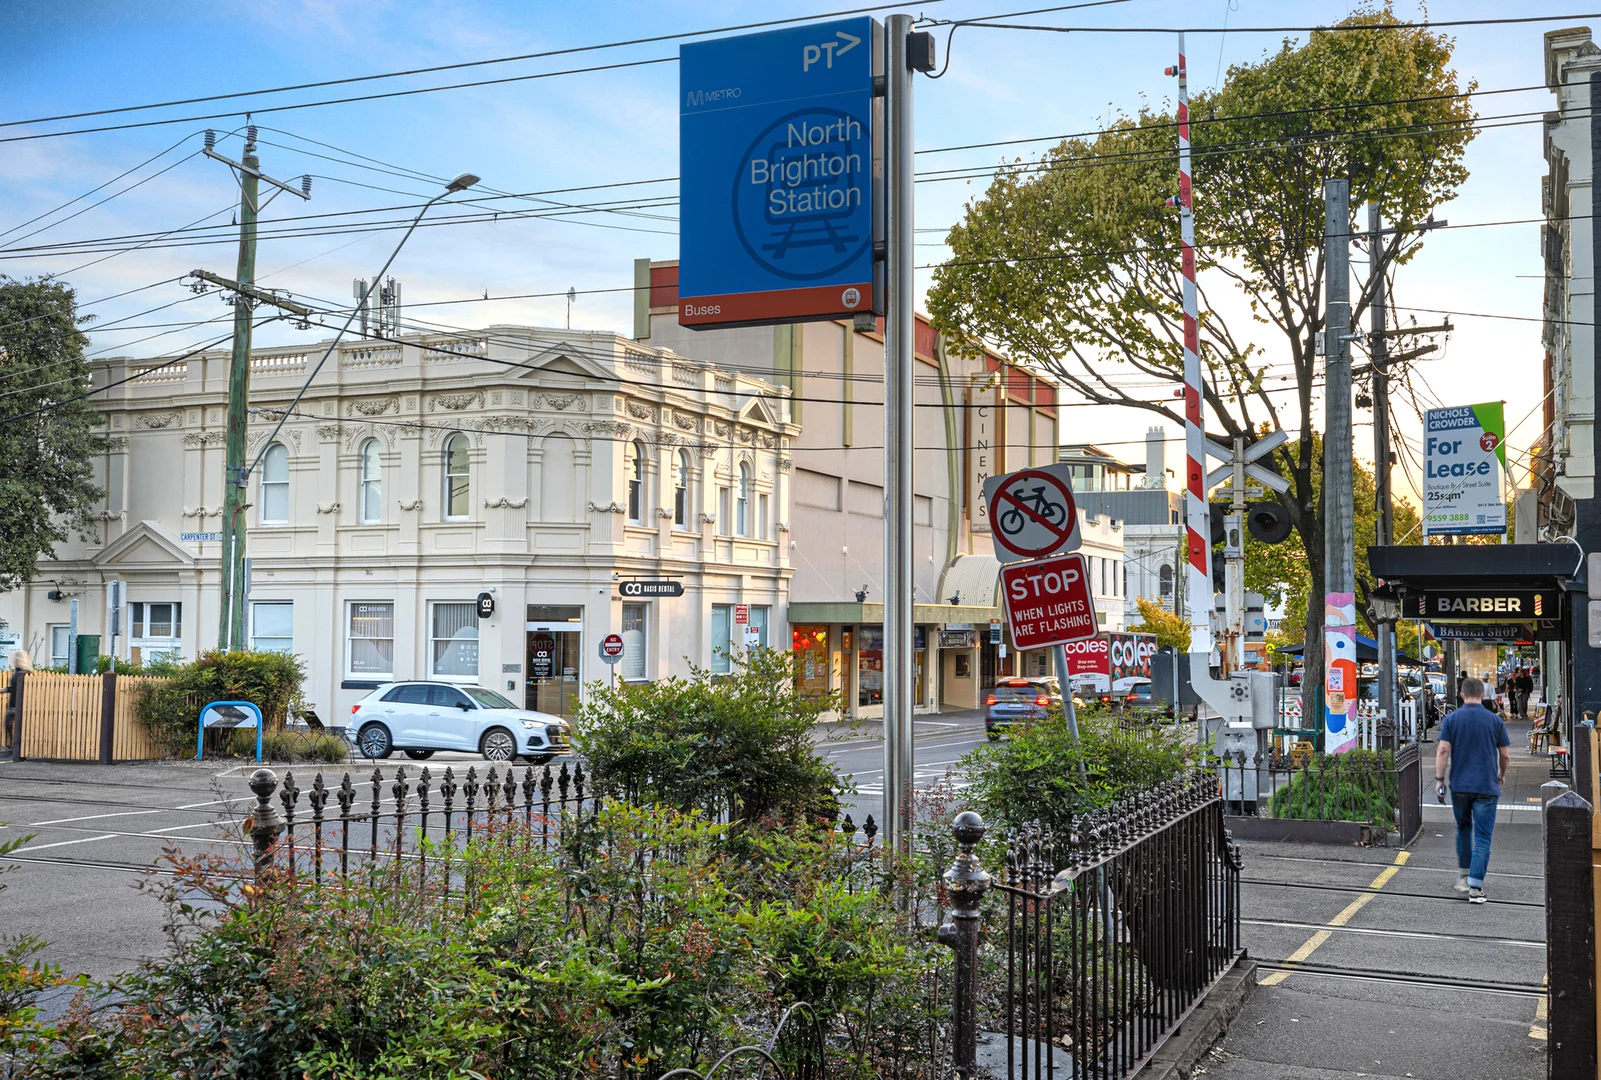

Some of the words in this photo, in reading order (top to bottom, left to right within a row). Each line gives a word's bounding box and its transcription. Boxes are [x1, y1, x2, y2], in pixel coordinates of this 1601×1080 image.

[705, 87, 742, 102] METRO
[788, 116, 861, 148] North
[751, 153, 861, 187] Brighton
[769, 186, 861, 215] Station
[685, 303, 721, 317] Buses
[1429, 408, 1469, 420] NICHOLS
[1429, 417, 1475, 429] CROWDER
[1427, 437, 1462, 456] For
[1485, 441, 1493, 451] 2
[977, 407, 988, 517] CINEMAS
[1427, 460, 1490, 478] Lease
[1462, 481, 1477, 489] Street
[1427, 514, 1447, 522] 9559
[1449, 513, 1469, 521] 3888
[181, 533, 208, 541] CARPENTER
[209, 533, 216, 541] ST
[658, 585, 675, 593] DENTAL
[1011, 569, 1079, 600] STOP
[1014, 607, 1044, 622] WHEN
[1048, 600, 1085, 616] LIGHTS
[1438, 598, 1521, 611] BARBER
[1015, 624, 1035, 637] ARE
[1040, 614, 1091, 633] FLASHING
[1439, 626, 1485, 637] BARBER
[1487, 626, 1518, 637] SHOP
[1065, 640, 1108, 654] coles
